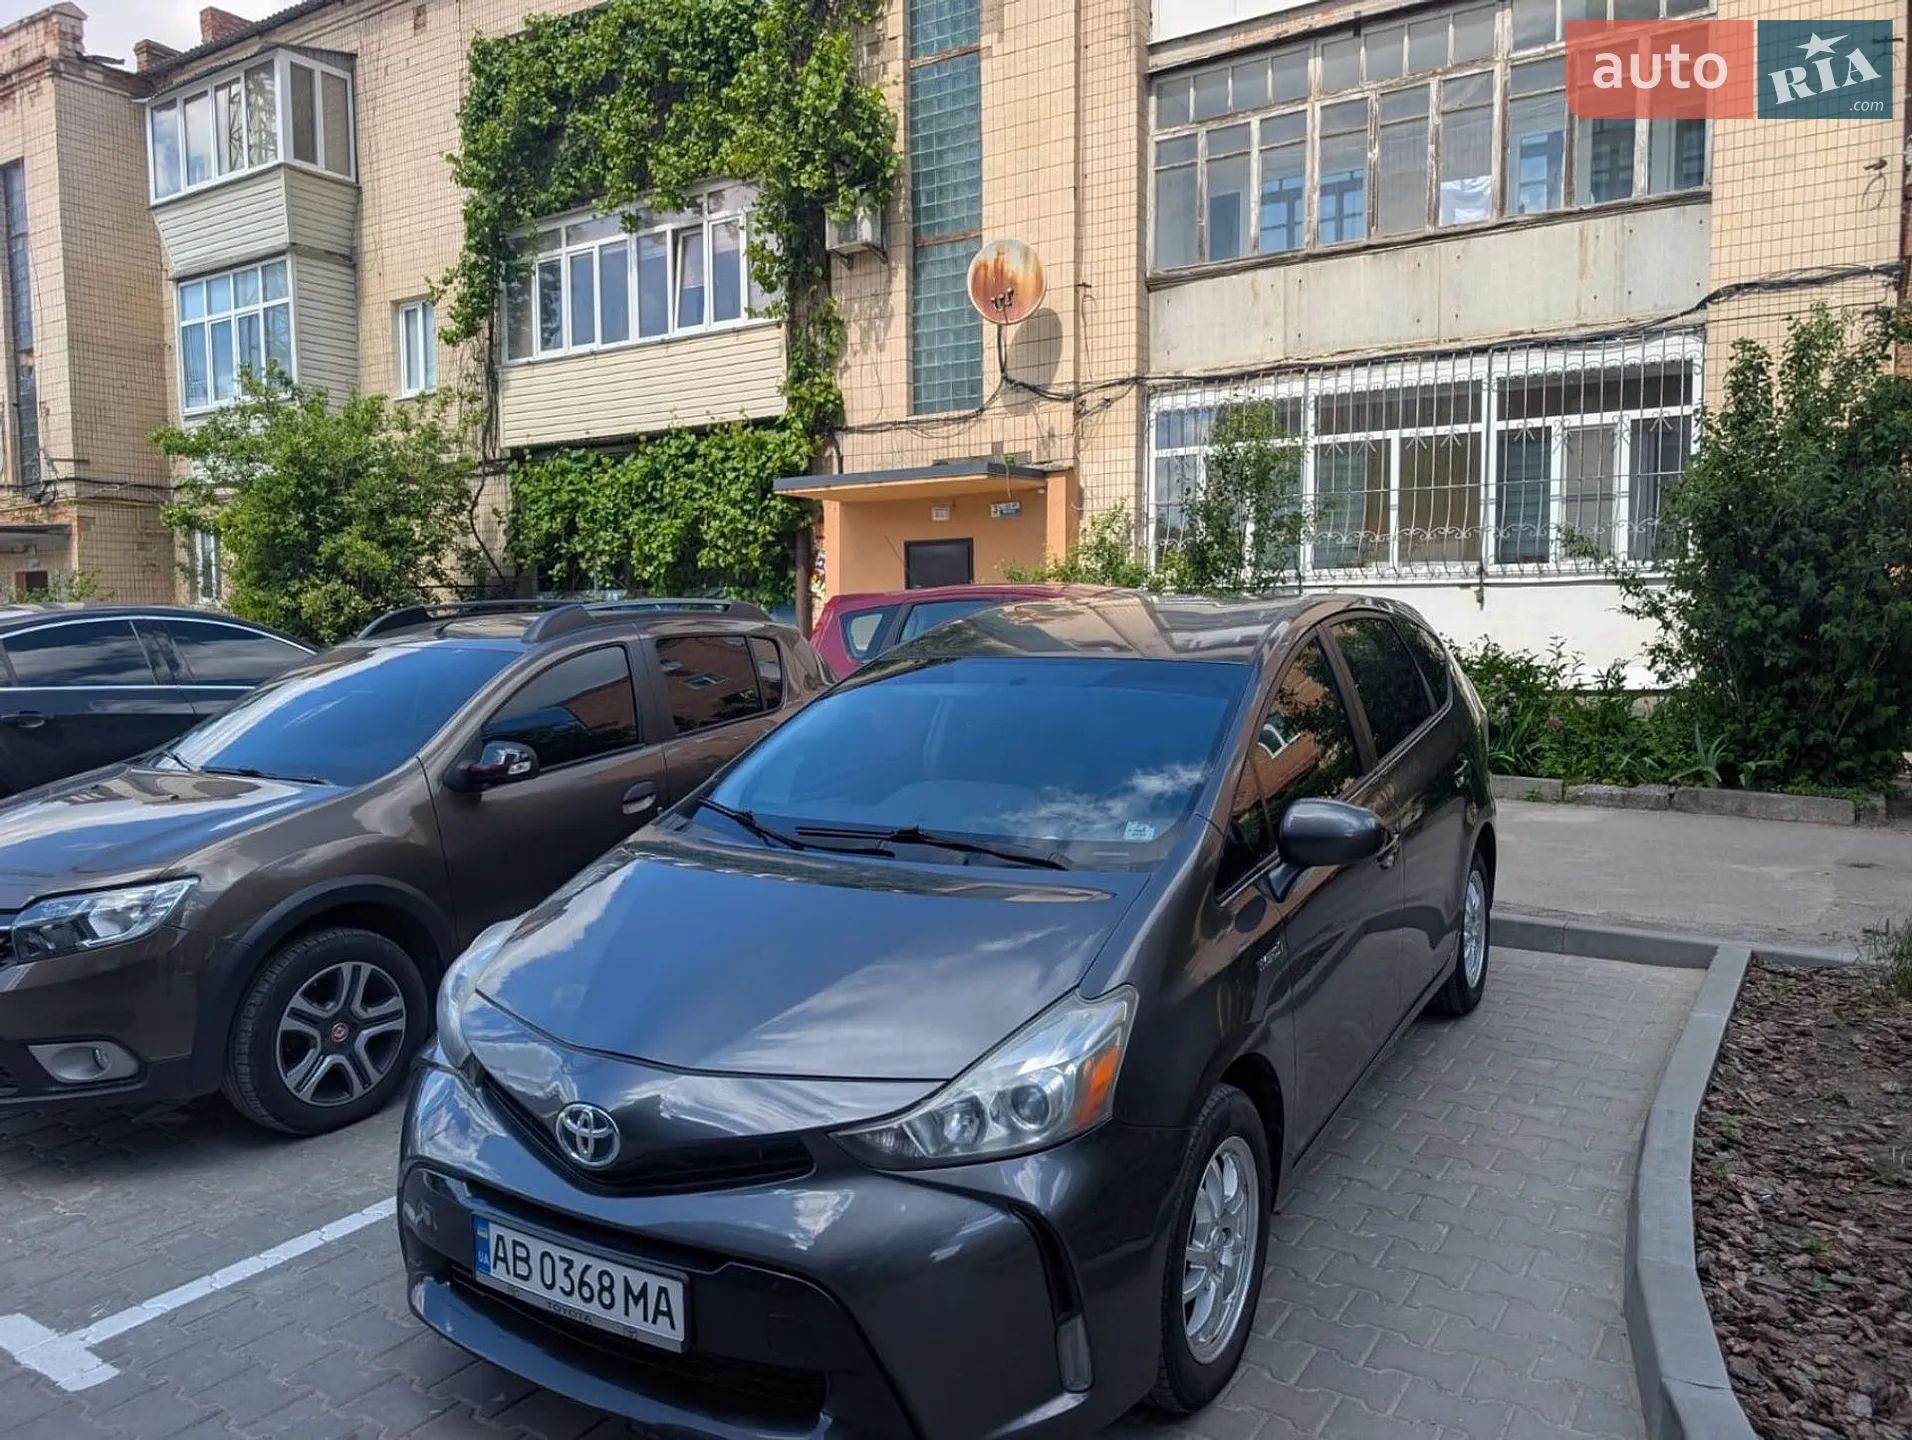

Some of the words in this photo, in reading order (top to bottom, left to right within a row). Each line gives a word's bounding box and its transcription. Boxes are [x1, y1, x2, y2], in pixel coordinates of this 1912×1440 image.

[477, 1250, 490, 1266] UA
[493, 1233, 533, 1282] AB
[539, 1250, 616, 1310] 0368
[623, 1274, 677, 1331] MA
